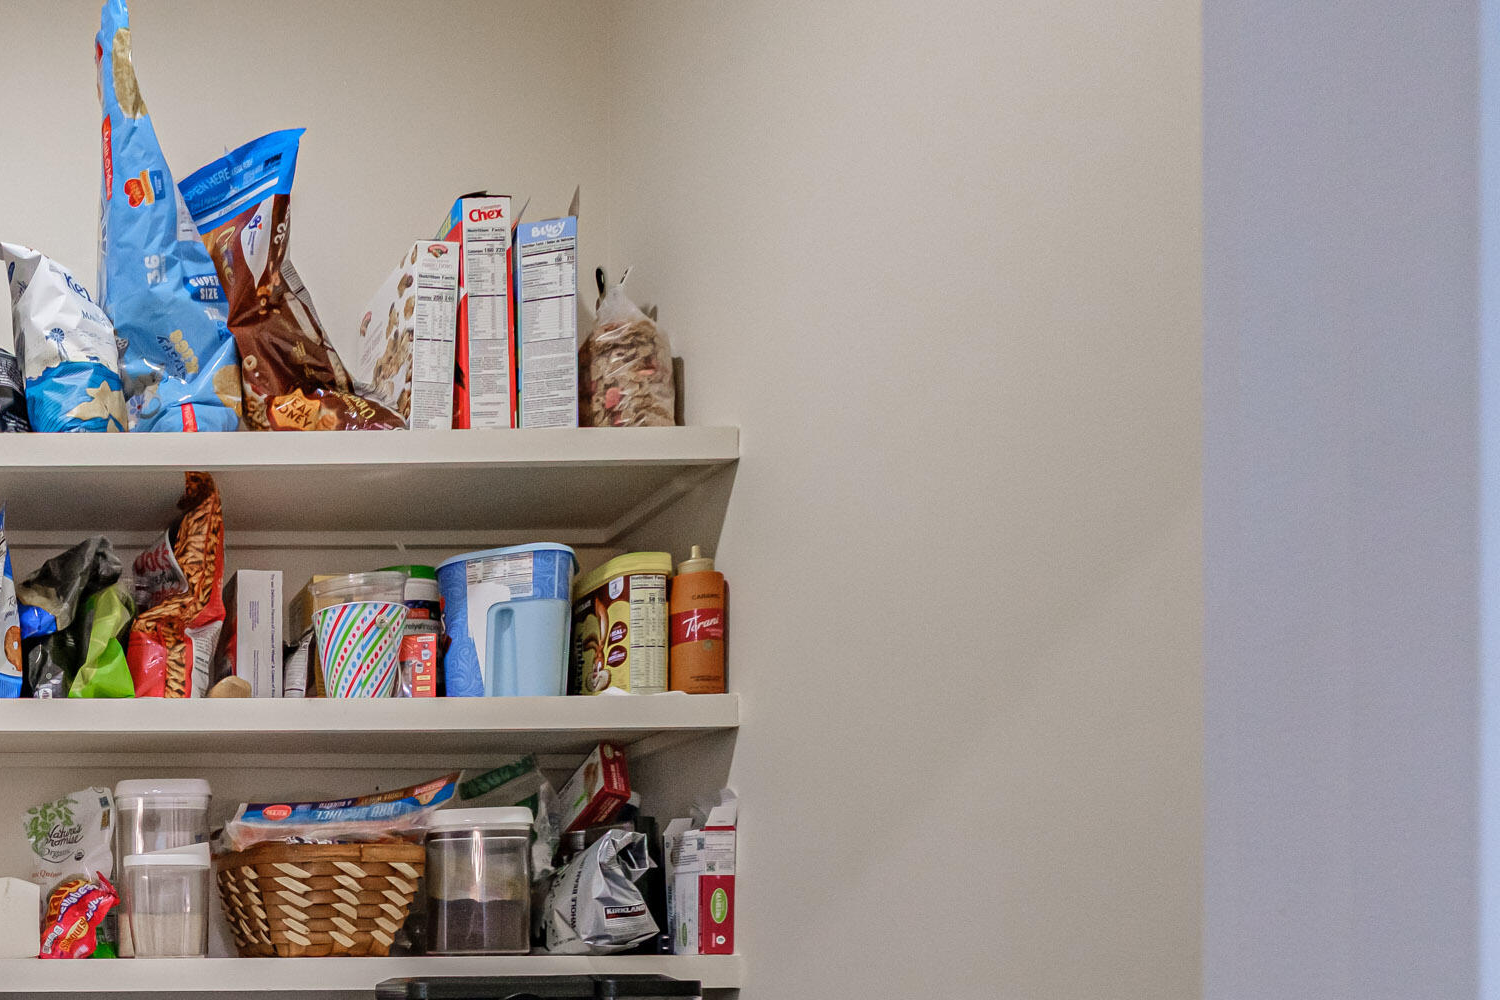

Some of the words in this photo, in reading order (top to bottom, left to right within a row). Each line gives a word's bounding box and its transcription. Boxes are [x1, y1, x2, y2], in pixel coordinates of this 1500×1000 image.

[208, 167, 231, 187] HERE
[469, 208, 503, 222] Chex
[274, 221, 288, 245] 32
[144, 254, 160, 285] 36
[189, 275, 221, 288] SUPER
[200, 288, 219, 300] SIZE
[682, 613, 720, 639] Torani
[607, 905, 646, 914] KIRKLAND
